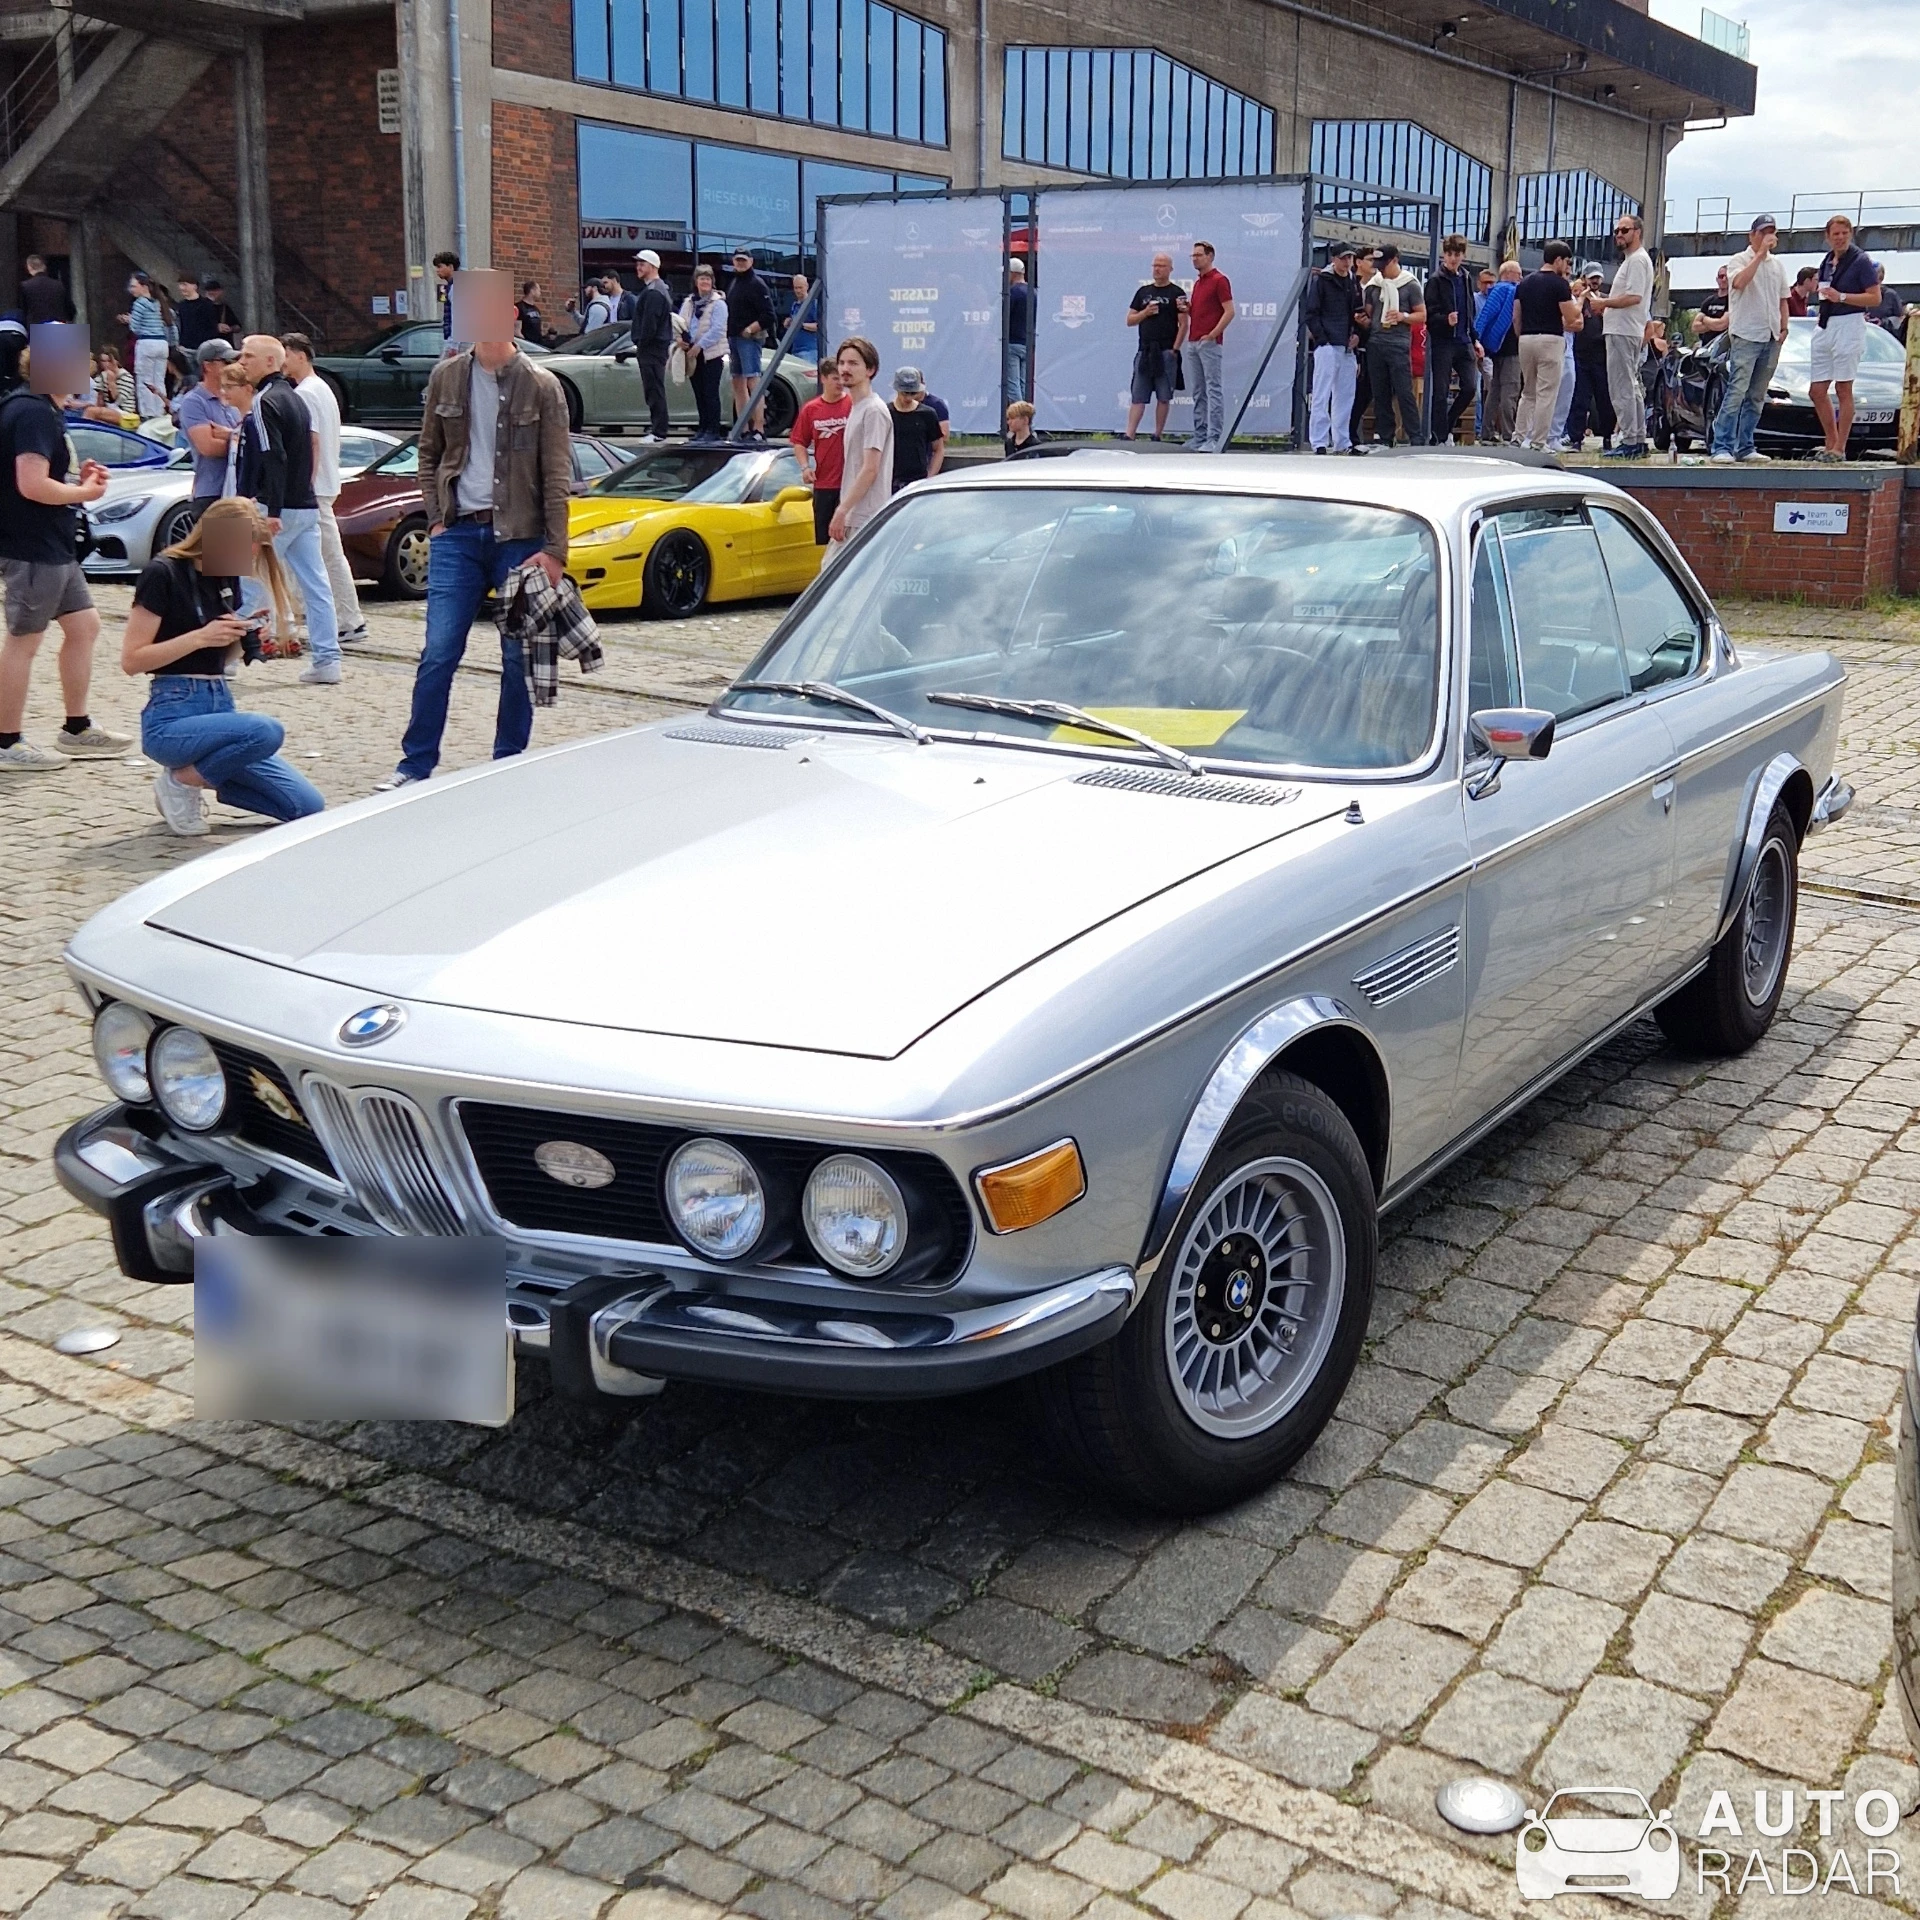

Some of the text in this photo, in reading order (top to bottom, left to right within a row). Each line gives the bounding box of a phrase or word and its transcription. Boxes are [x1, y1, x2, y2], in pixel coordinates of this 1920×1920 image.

[703, 188, 738, 206] RIESE
[1862, 411, 1894, 422] JB 99
[1807, 508, 1848, 518] team 08
[1806, 518, 1834, 527] neusta
[902, 580, 929, 594] 1278
